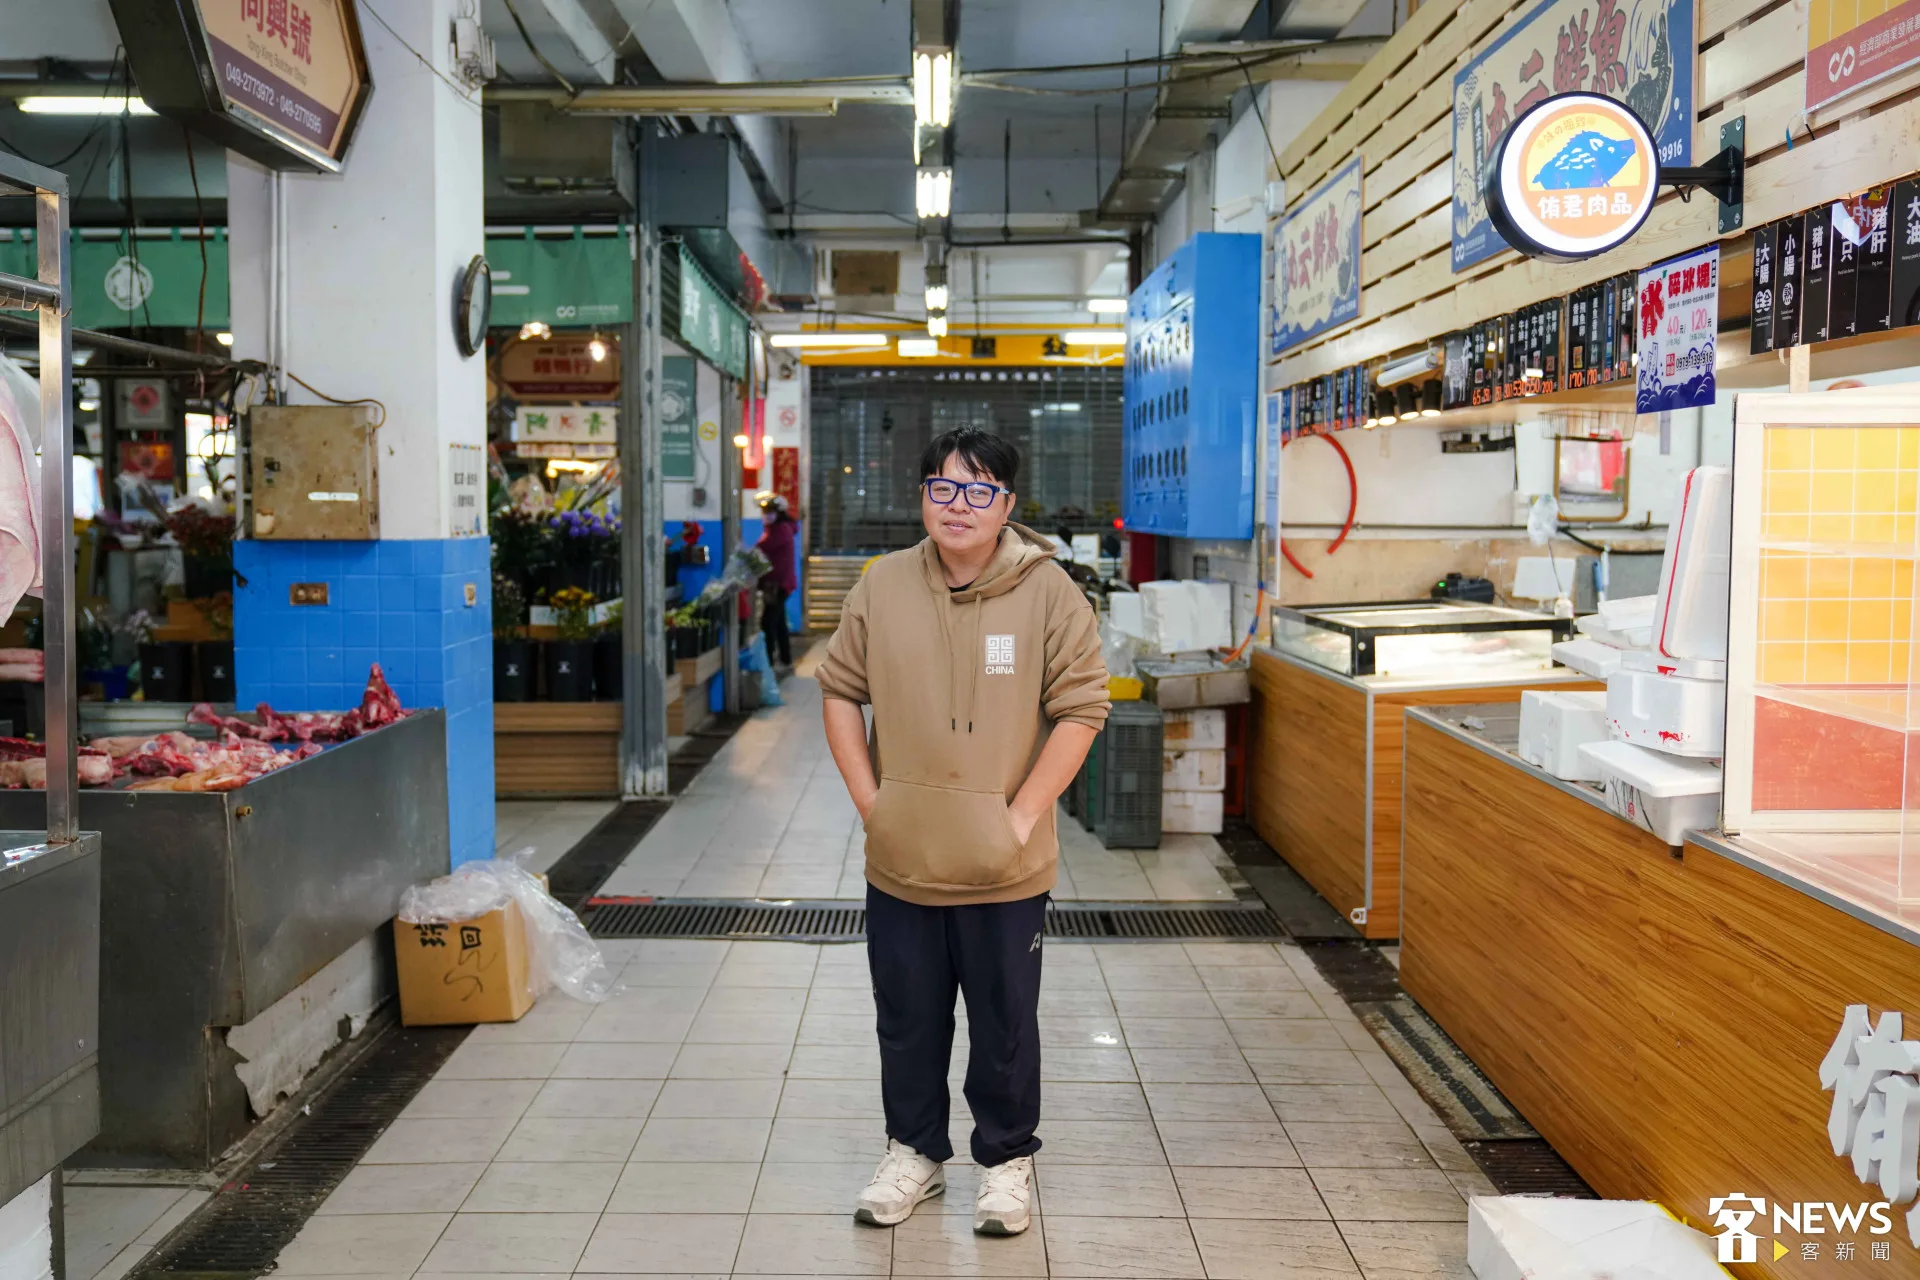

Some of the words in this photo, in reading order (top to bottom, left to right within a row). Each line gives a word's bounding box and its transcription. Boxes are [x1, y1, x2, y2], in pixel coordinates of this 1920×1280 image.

[1536, 191, 1633, 220] 侑君肉品
[1810, 225, 1824, 271] 豬肚
[1870, 205, 1888, 255] 豬肝
[1759, 242, 1771, 285] 大腸
[1783, 233, 1795, 277] 小腸
[1668, 262, 1711, 299] 碎冰塊
[1667, 315, 1680, 336] 40
[1691, 307, 1708, 332] 120
[985, 665, 1015, 675] CHINA
